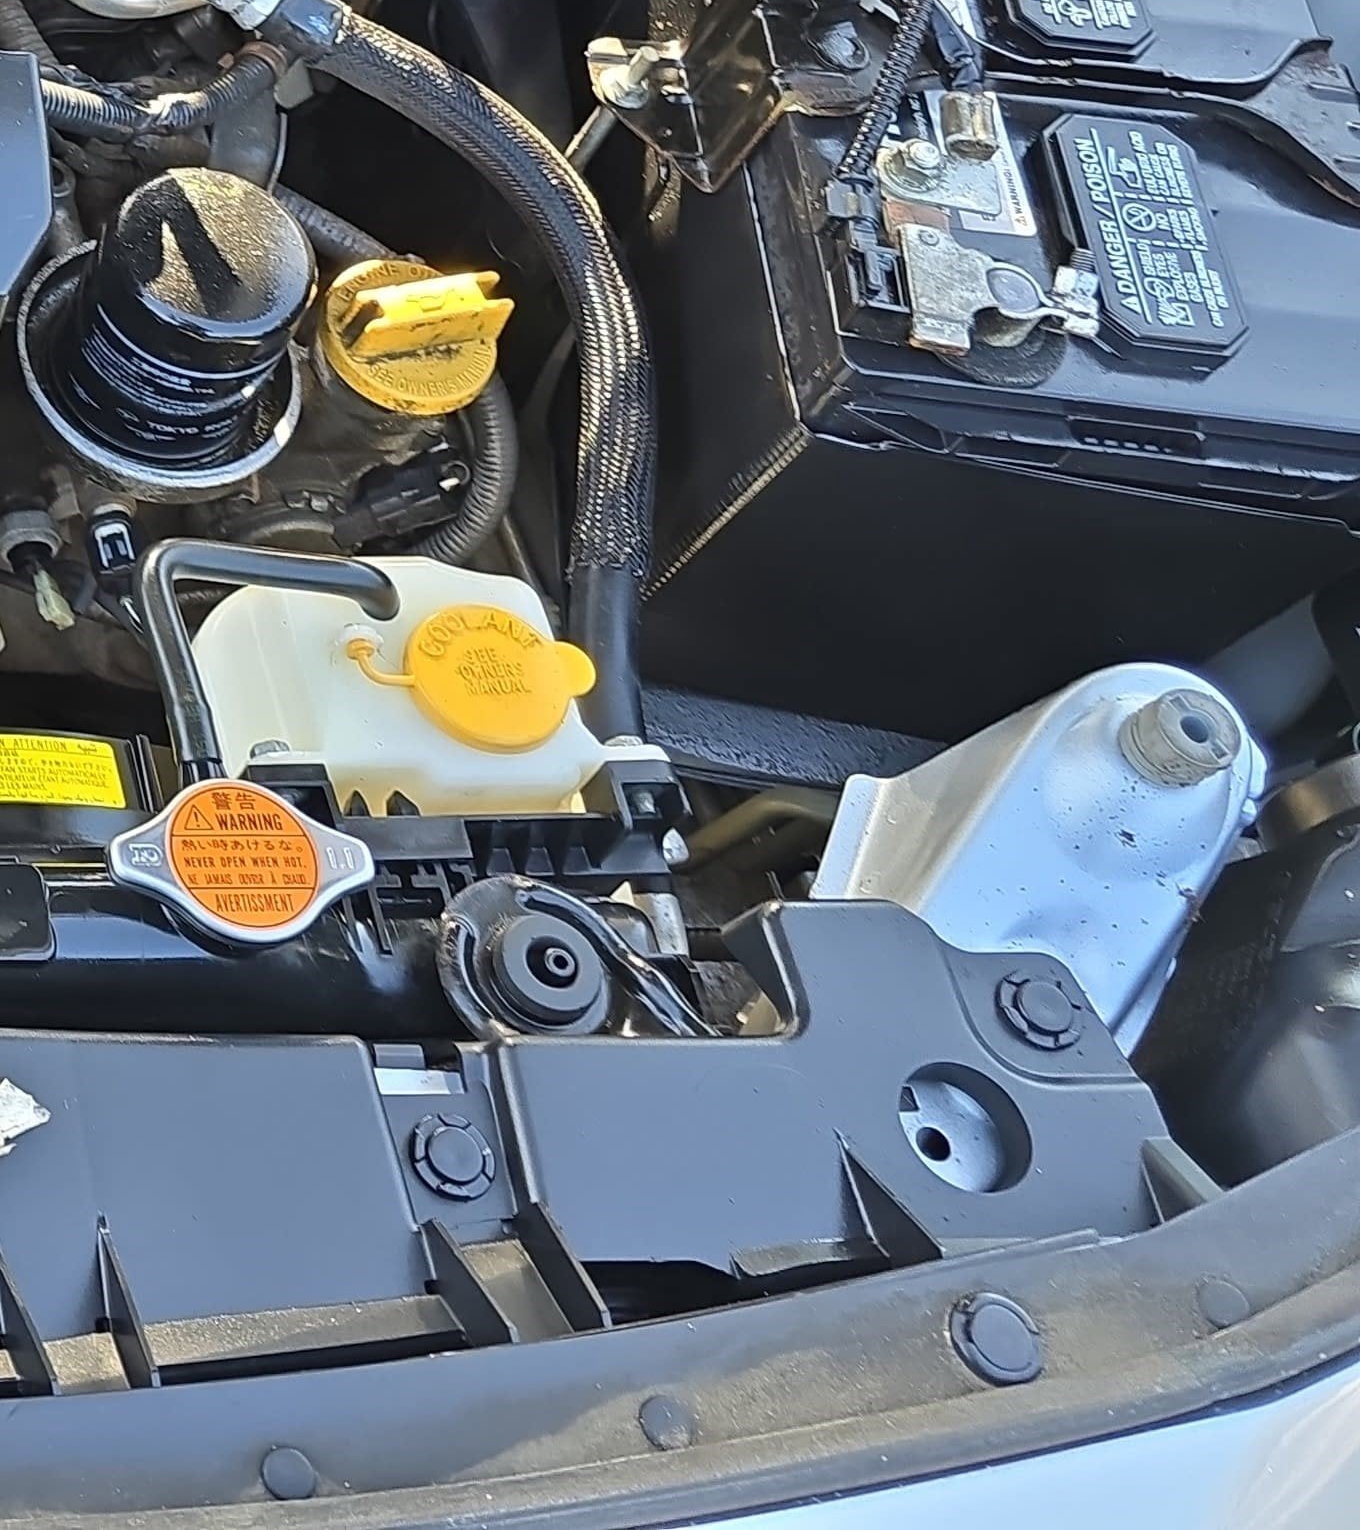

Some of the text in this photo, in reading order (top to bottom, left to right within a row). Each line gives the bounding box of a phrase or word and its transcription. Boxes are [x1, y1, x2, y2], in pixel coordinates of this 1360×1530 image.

[1074, 138, 1110, 202] POISON
[1155, 213, 1171, 230] NO
[1099, 220, 1136, 294] DANGER
[1152, 254, 1169, 278] EYES
[337, 262, 400, 302] ENGINE
[368, 364, 393, 388] SEE
[458, 347, 492, 389] MANUAL
[419, 611, 543, 657] COOLANT
[464, 648, 498, 664] SEE
[464, 681, 530, 696] MANUAL
[14, 738, 67, 752] ATTENTION
[211, 791, 256, 810] 警告
[215, 814, 283, 830] WARNING
[183, 856, 307, 868] NEVER OPEN WHEN HOT.
[204, 874, 232, 885] JAMAIS
[215, 894, 294, 912] AVERTISSMENT
